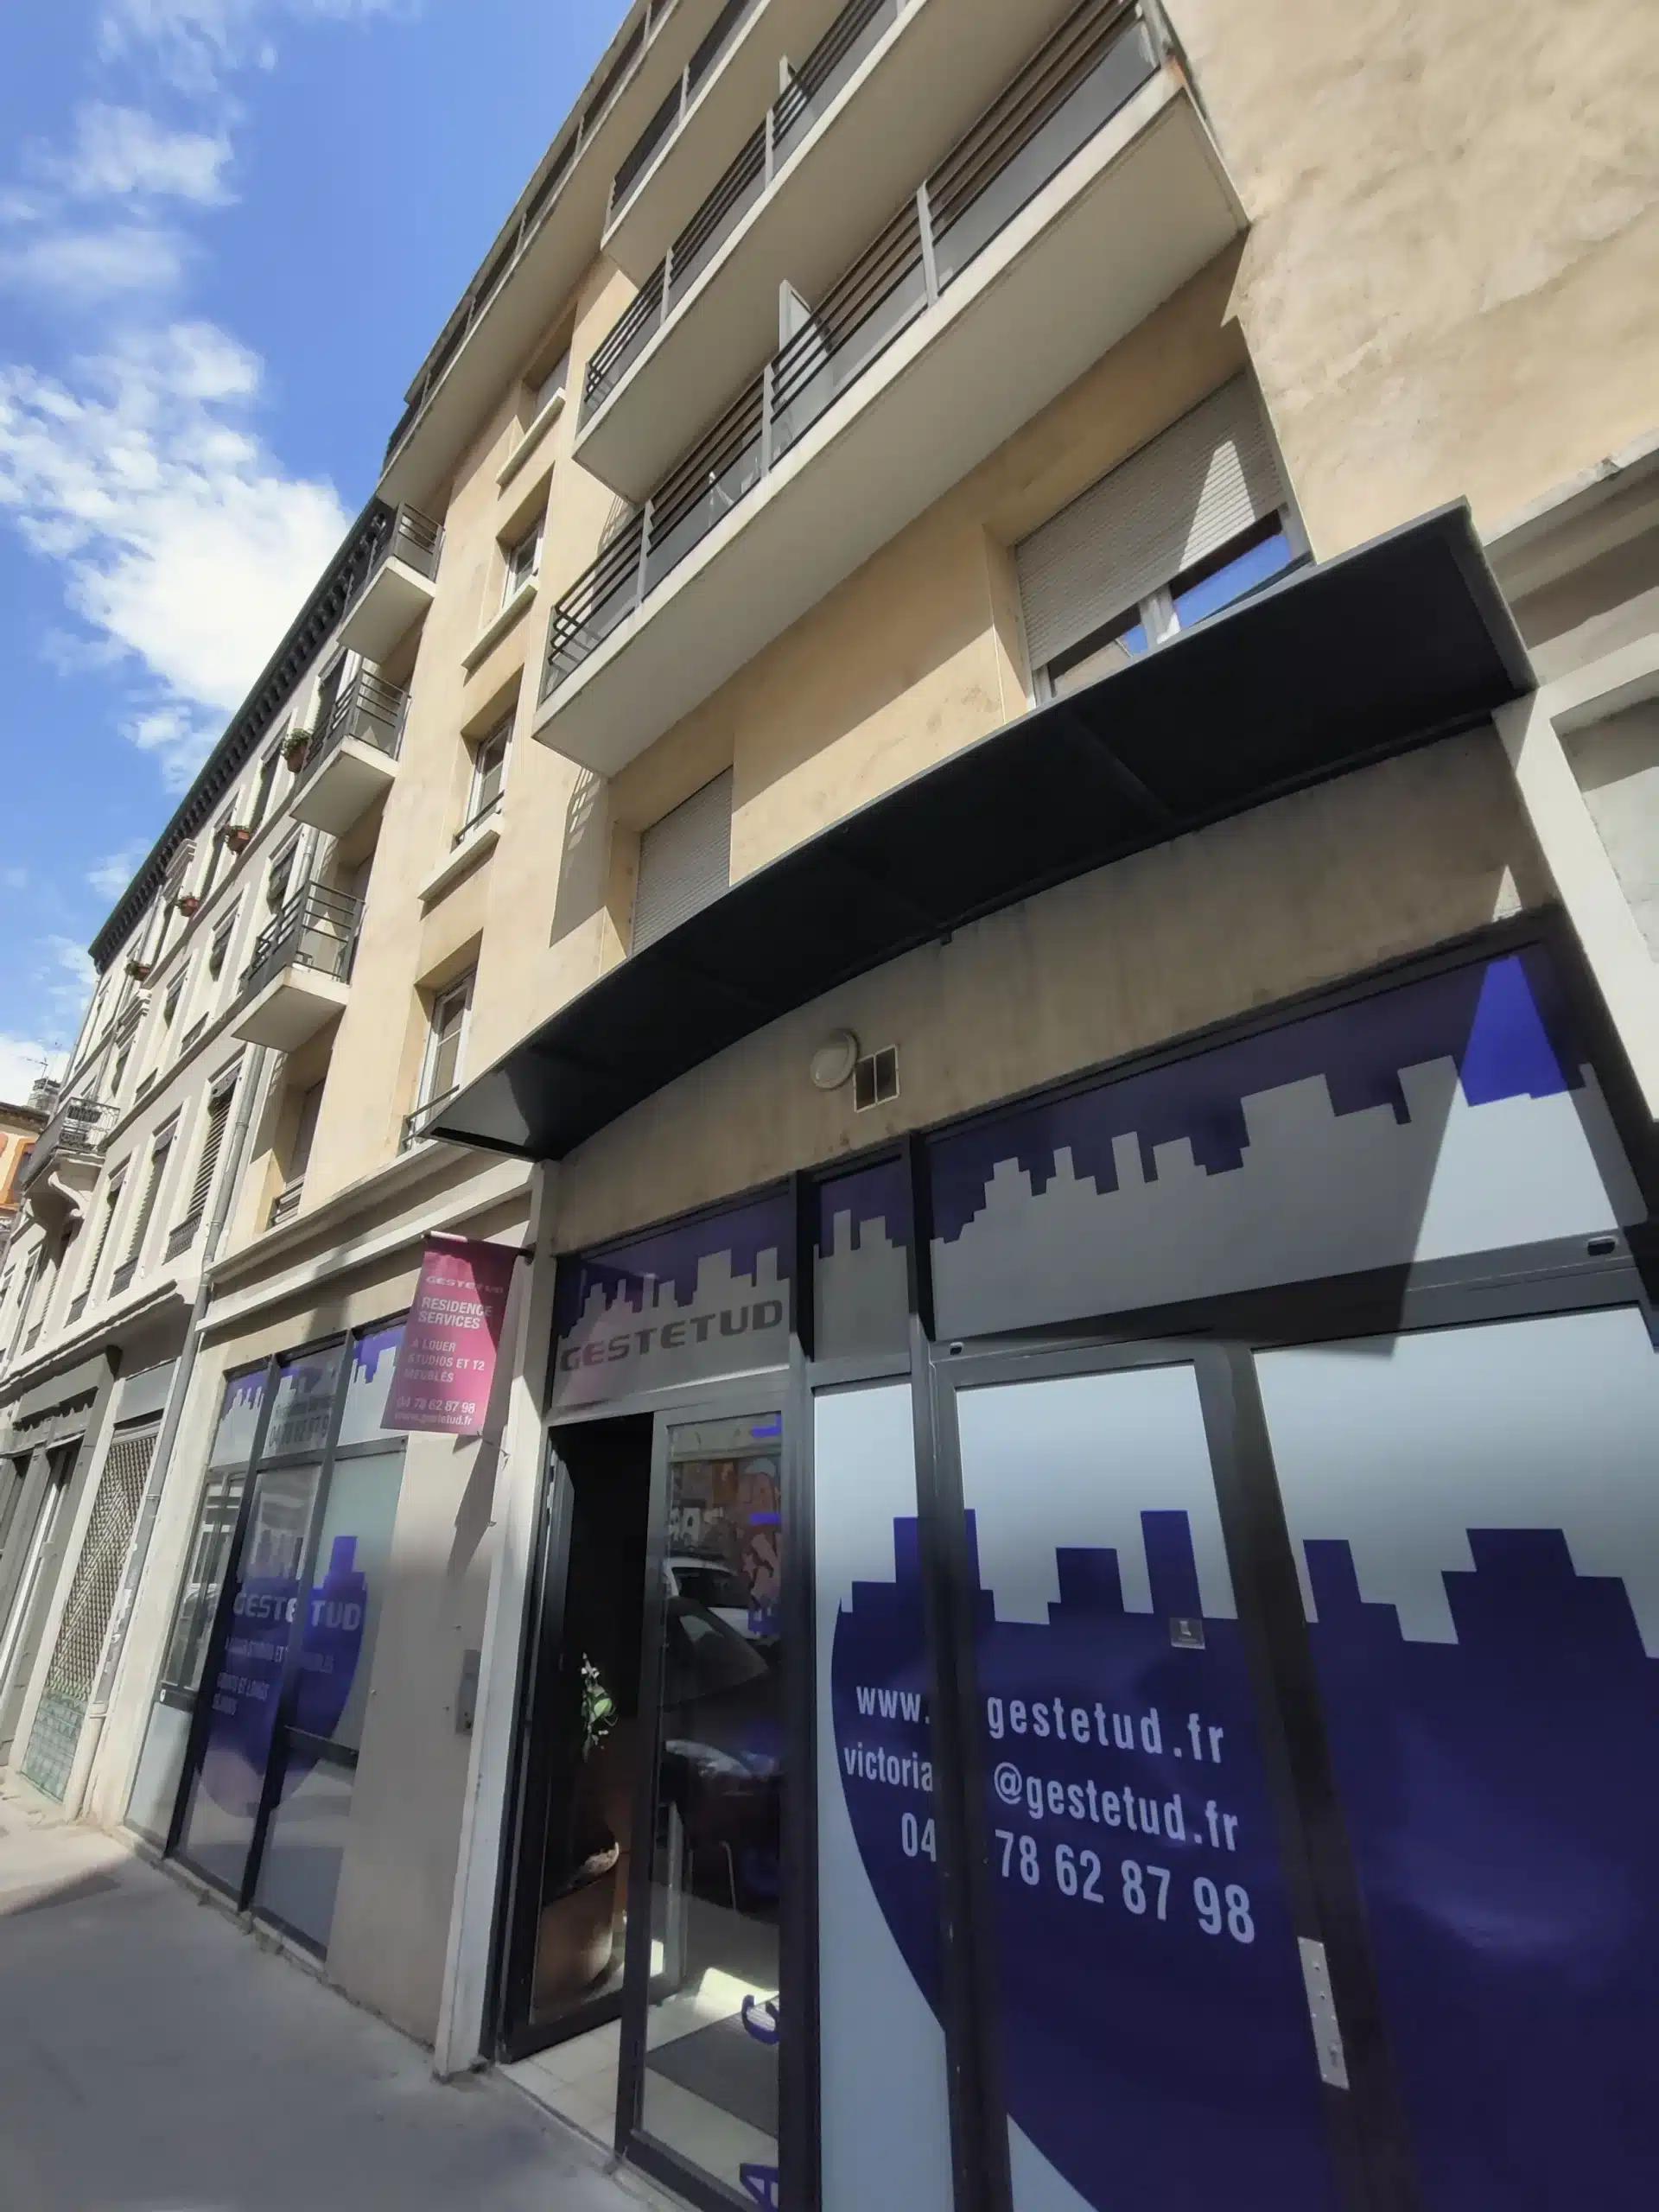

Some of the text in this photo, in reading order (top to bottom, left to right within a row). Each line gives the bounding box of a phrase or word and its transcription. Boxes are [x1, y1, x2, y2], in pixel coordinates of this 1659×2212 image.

[421, 1296, 493, 1318] RESIDENCE
[418, 1311, 480, 1330] SERVICES
[422, 1338, 456, 1352] LOUER
[561, 1299, 783, 1372] GESTETUD
[407, 1352, 486, 1371] STUDIOS ET T2
[444, 1400, 460, 1413] 87
[461, 1401, 476, 1414] 98
[855, 1686, 1224, 1764] www. gestetud.fr
[843, 1742, 1239, 1852] victoria @gestetud.fr
[901, 1813, 1255, 1945] 04 78 62 87 98
